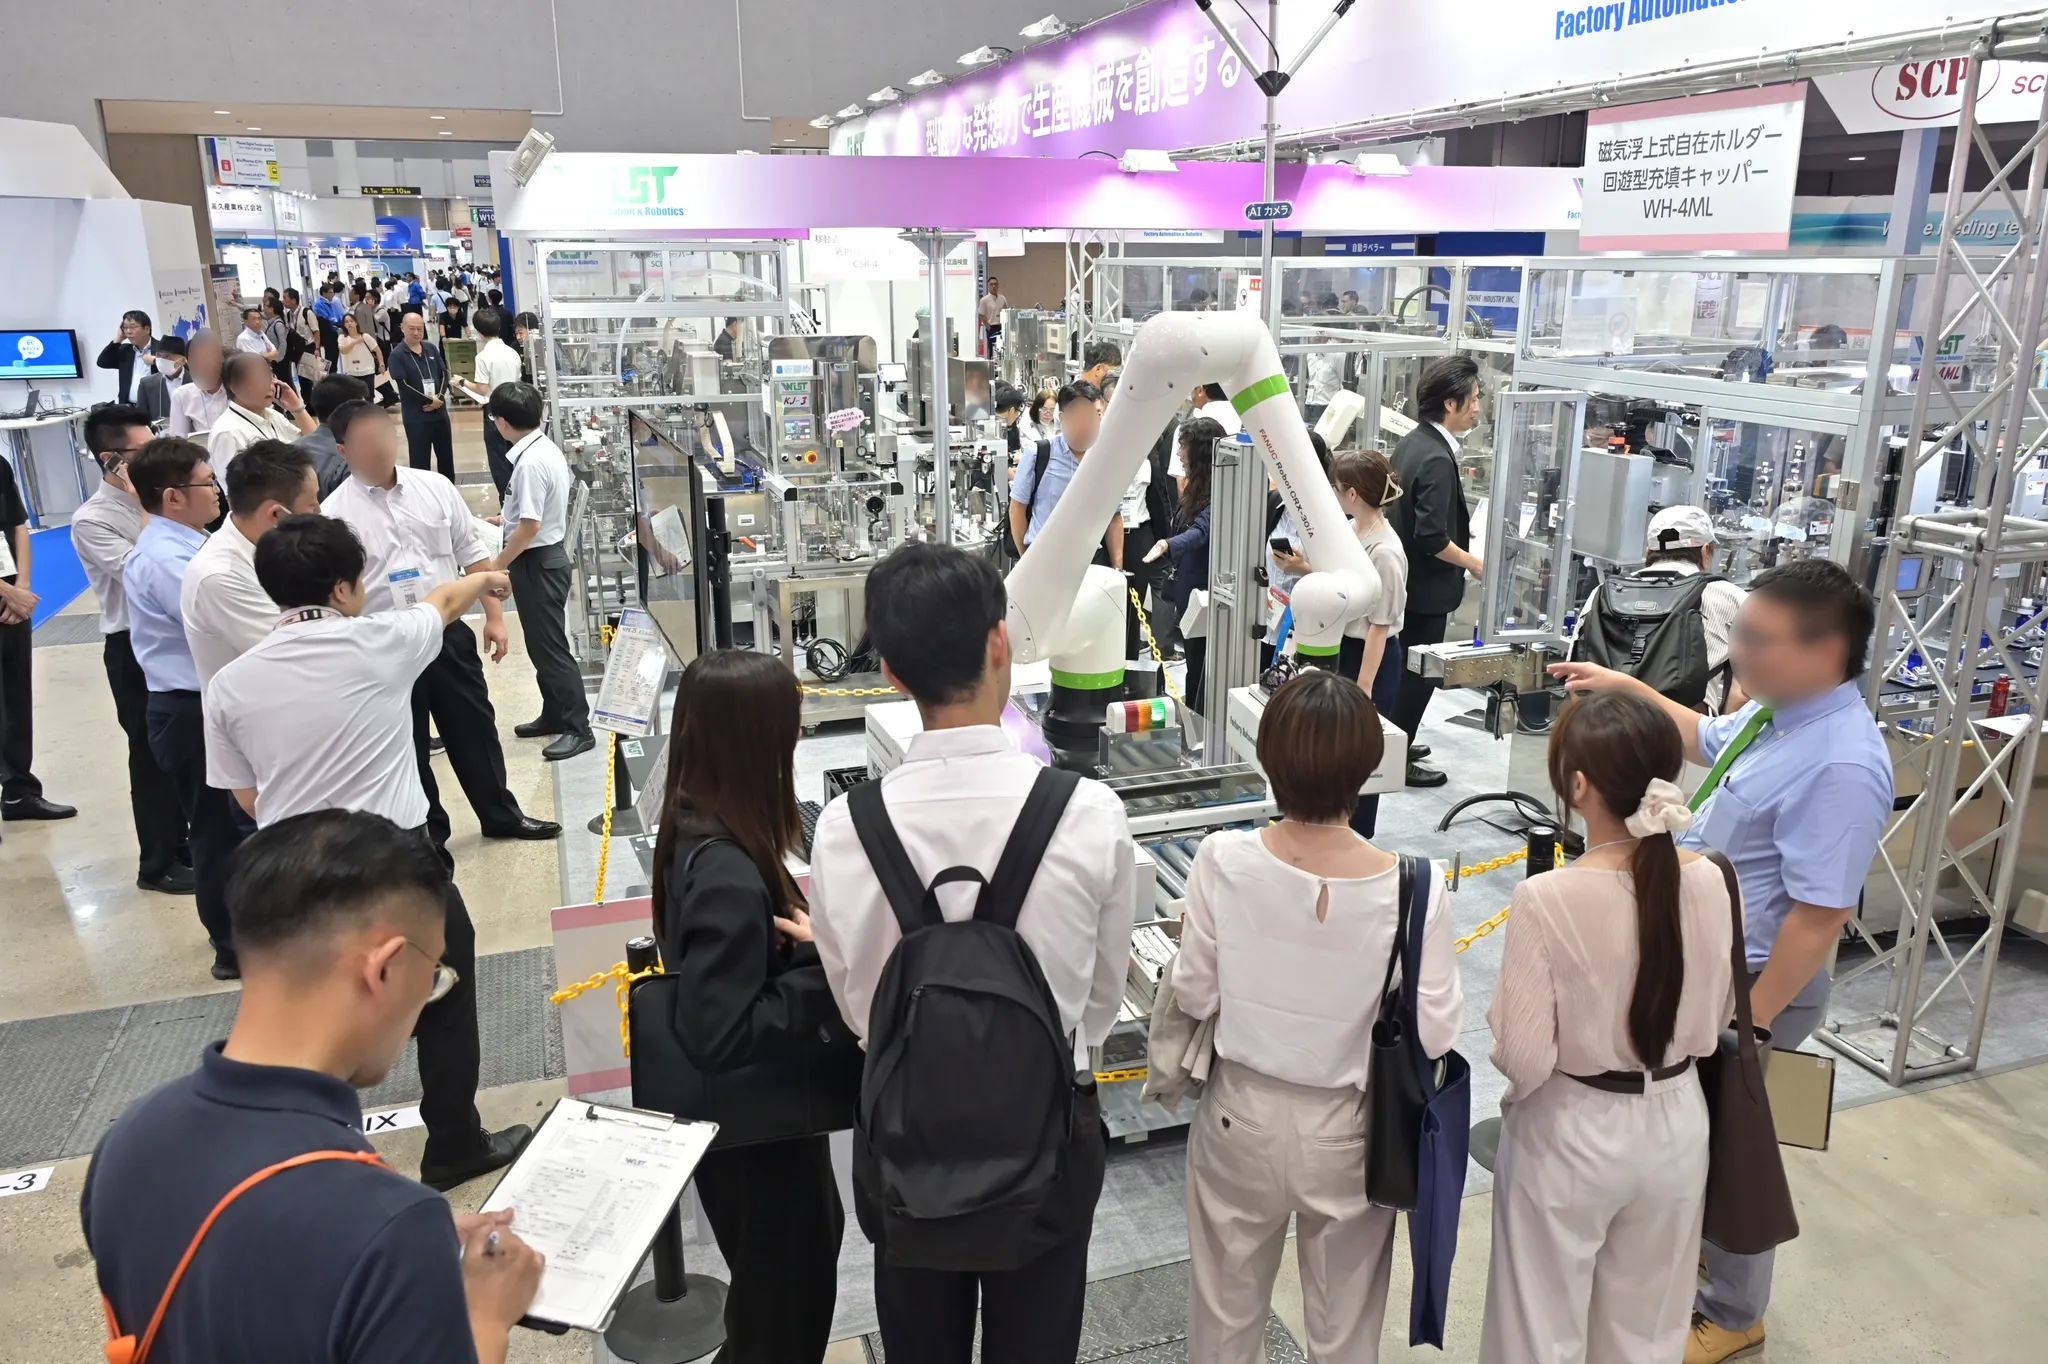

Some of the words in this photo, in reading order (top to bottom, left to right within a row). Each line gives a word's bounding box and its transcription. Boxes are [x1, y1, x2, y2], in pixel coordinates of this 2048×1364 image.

[1555, 0, 1625, 40] Factory
[2012, 75, 2047, 95] SC
[1598, 124, 1782, 163] 磁気浮上式自在ホルダー
[1602, 160, 1769, 193] 回遊型充填キャッパー
[645, 207, 684, 216] Robotics
[1249, 206, 1261, 217] AI
[1264, 205, 1289, 216] カメラ
[1643, 196, 1713, 218] WH-4ML
[1352, 243, 1385, 252] 自動ラベラー
[784, 396, 807, 405] KJ-3
[1259, 428, 1278, 460] FANUC
[1276, 462, 1292, 490] Robot
[1289, 490, 1315, 539] CRX-30iA
